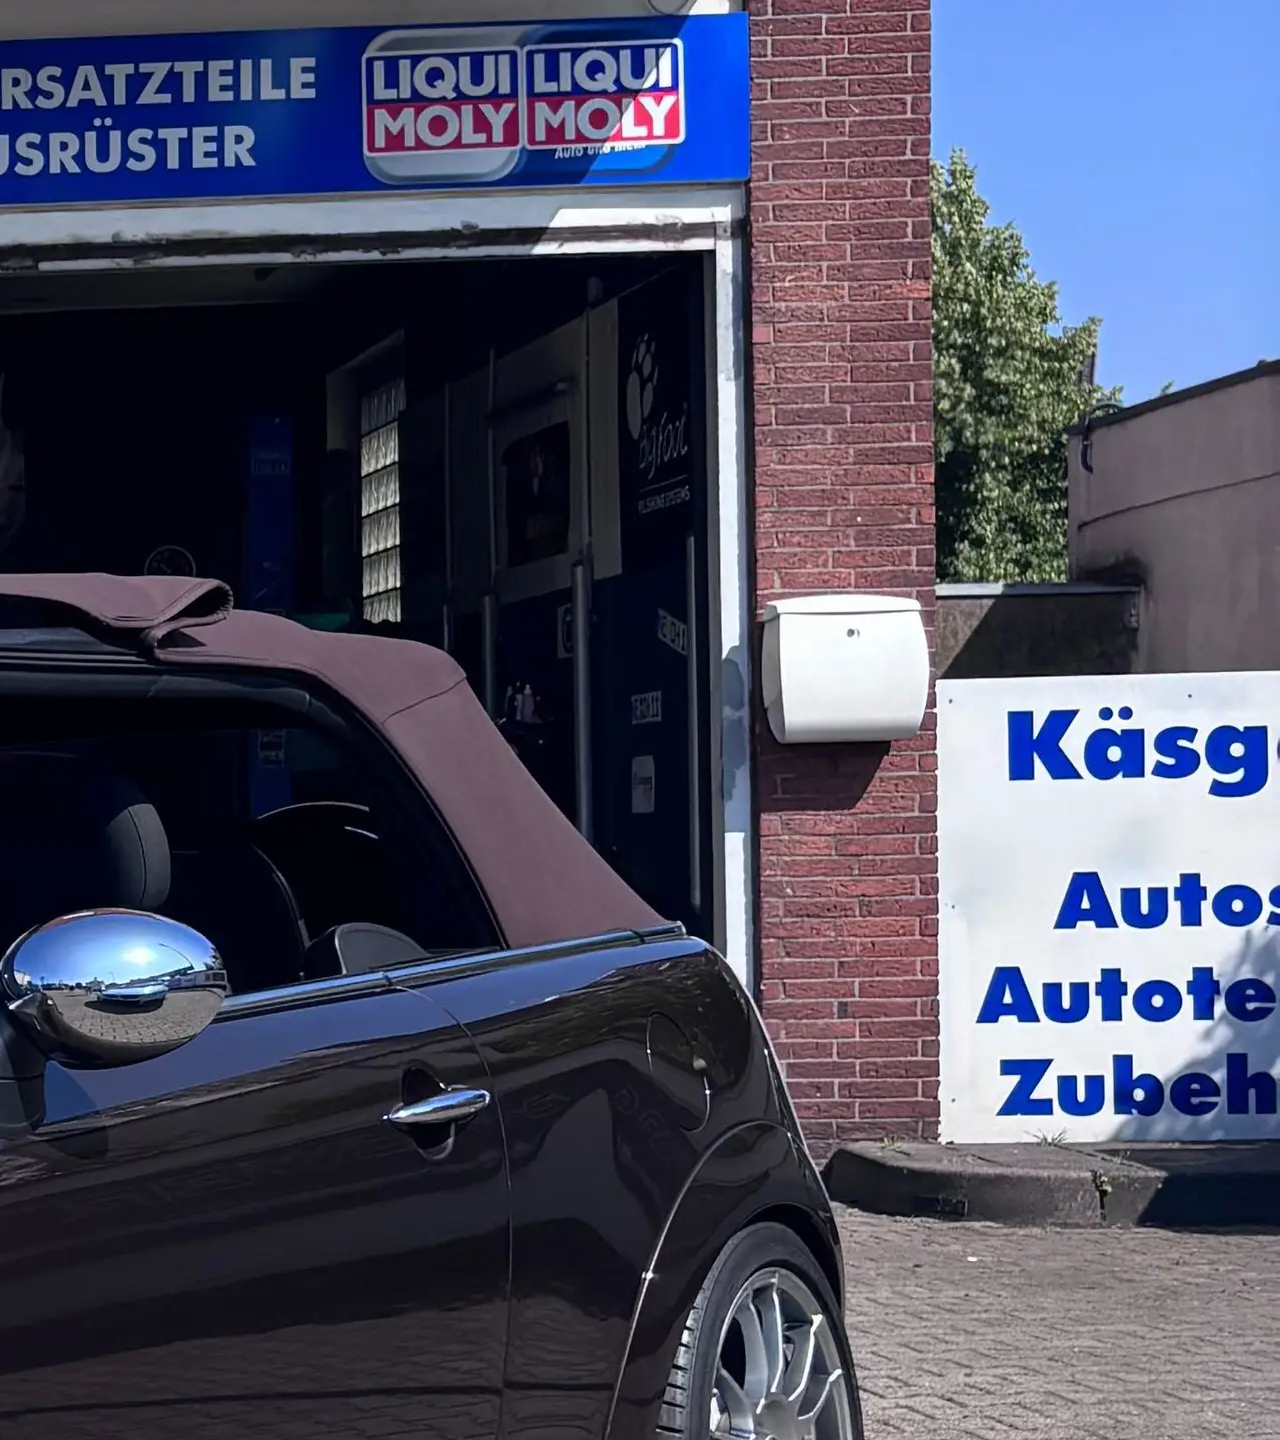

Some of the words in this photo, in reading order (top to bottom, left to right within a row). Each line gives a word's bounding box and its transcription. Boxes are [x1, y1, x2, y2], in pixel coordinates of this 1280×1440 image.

[372, 54, 511, 101] LIQUI
[533, 47, 673, 96] LIQUI
[374, 103, 517, 148] MOLY
[534, 94, 676, 143] MOLY
[1007, 705, 1280, 798] Käsg
[976, 966, 1277, 1024] Autote
[996, 1053, 1277, 1117] Zubeh
